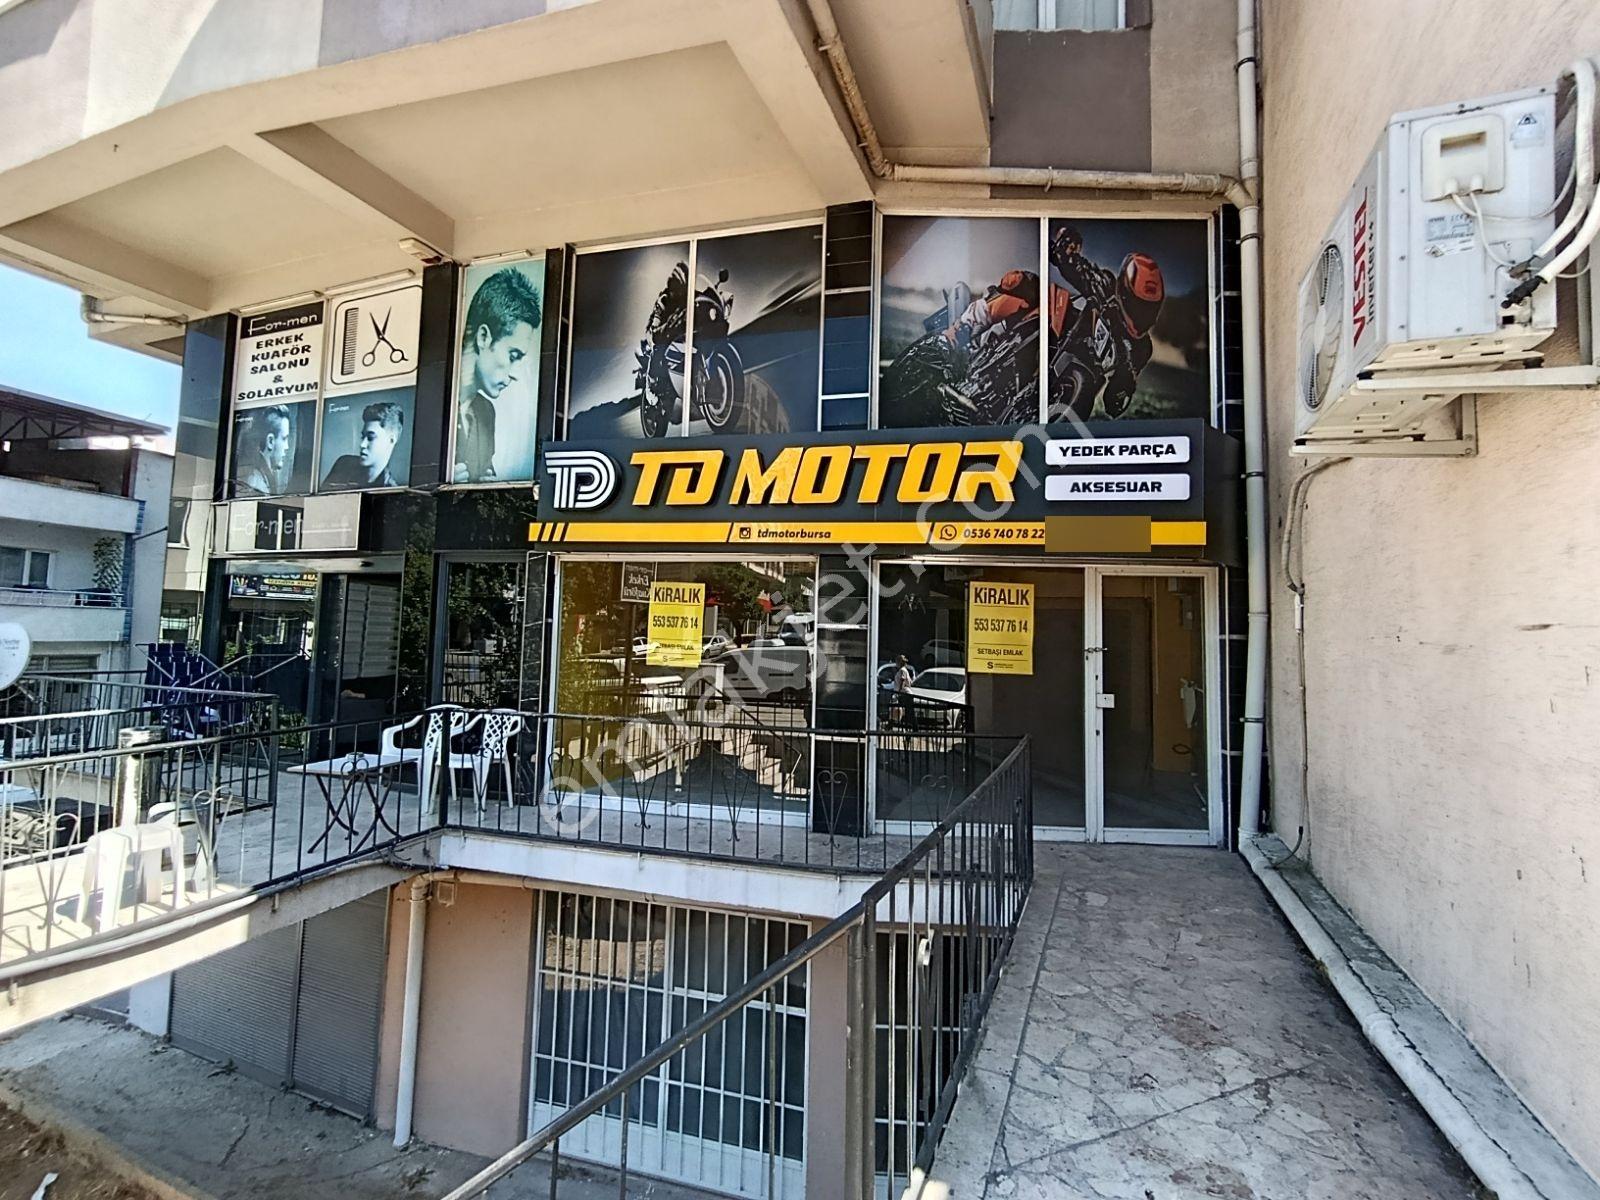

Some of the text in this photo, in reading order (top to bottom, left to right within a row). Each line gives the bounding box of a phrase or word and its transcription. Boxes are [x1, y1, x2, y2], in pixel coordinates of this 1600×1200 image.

[1353, 186, 1368, 348] VESTEL
[248, 314, 318, 336] For-men
[256, 333, 304, 350] ERKEK
[251, 344, 312, 363] KUAFÖR
[250, 357, 310, 375] SALONU
[272, 374, 284, 383] &
[237, 381, 319, 401] SOLARYUM
[1059, 443, 1177, 458] YEDEK PARÇA
[630, 441, 1024, 506] TD MOTOR
[1070, 481, 1162, 493] AKSESUAR
[757, 528, 831, 539] tdmotorbursa
[963, 528, 1045, 539] 0536 740 78 22
[653, 615, 698, 629] 553 537 76 14
[974, 618, 1028, 633] 553 537 76 14
[977, 648, 1023, 656] SETBAŞI EMLAK
[987, 661, 994, 669] S
